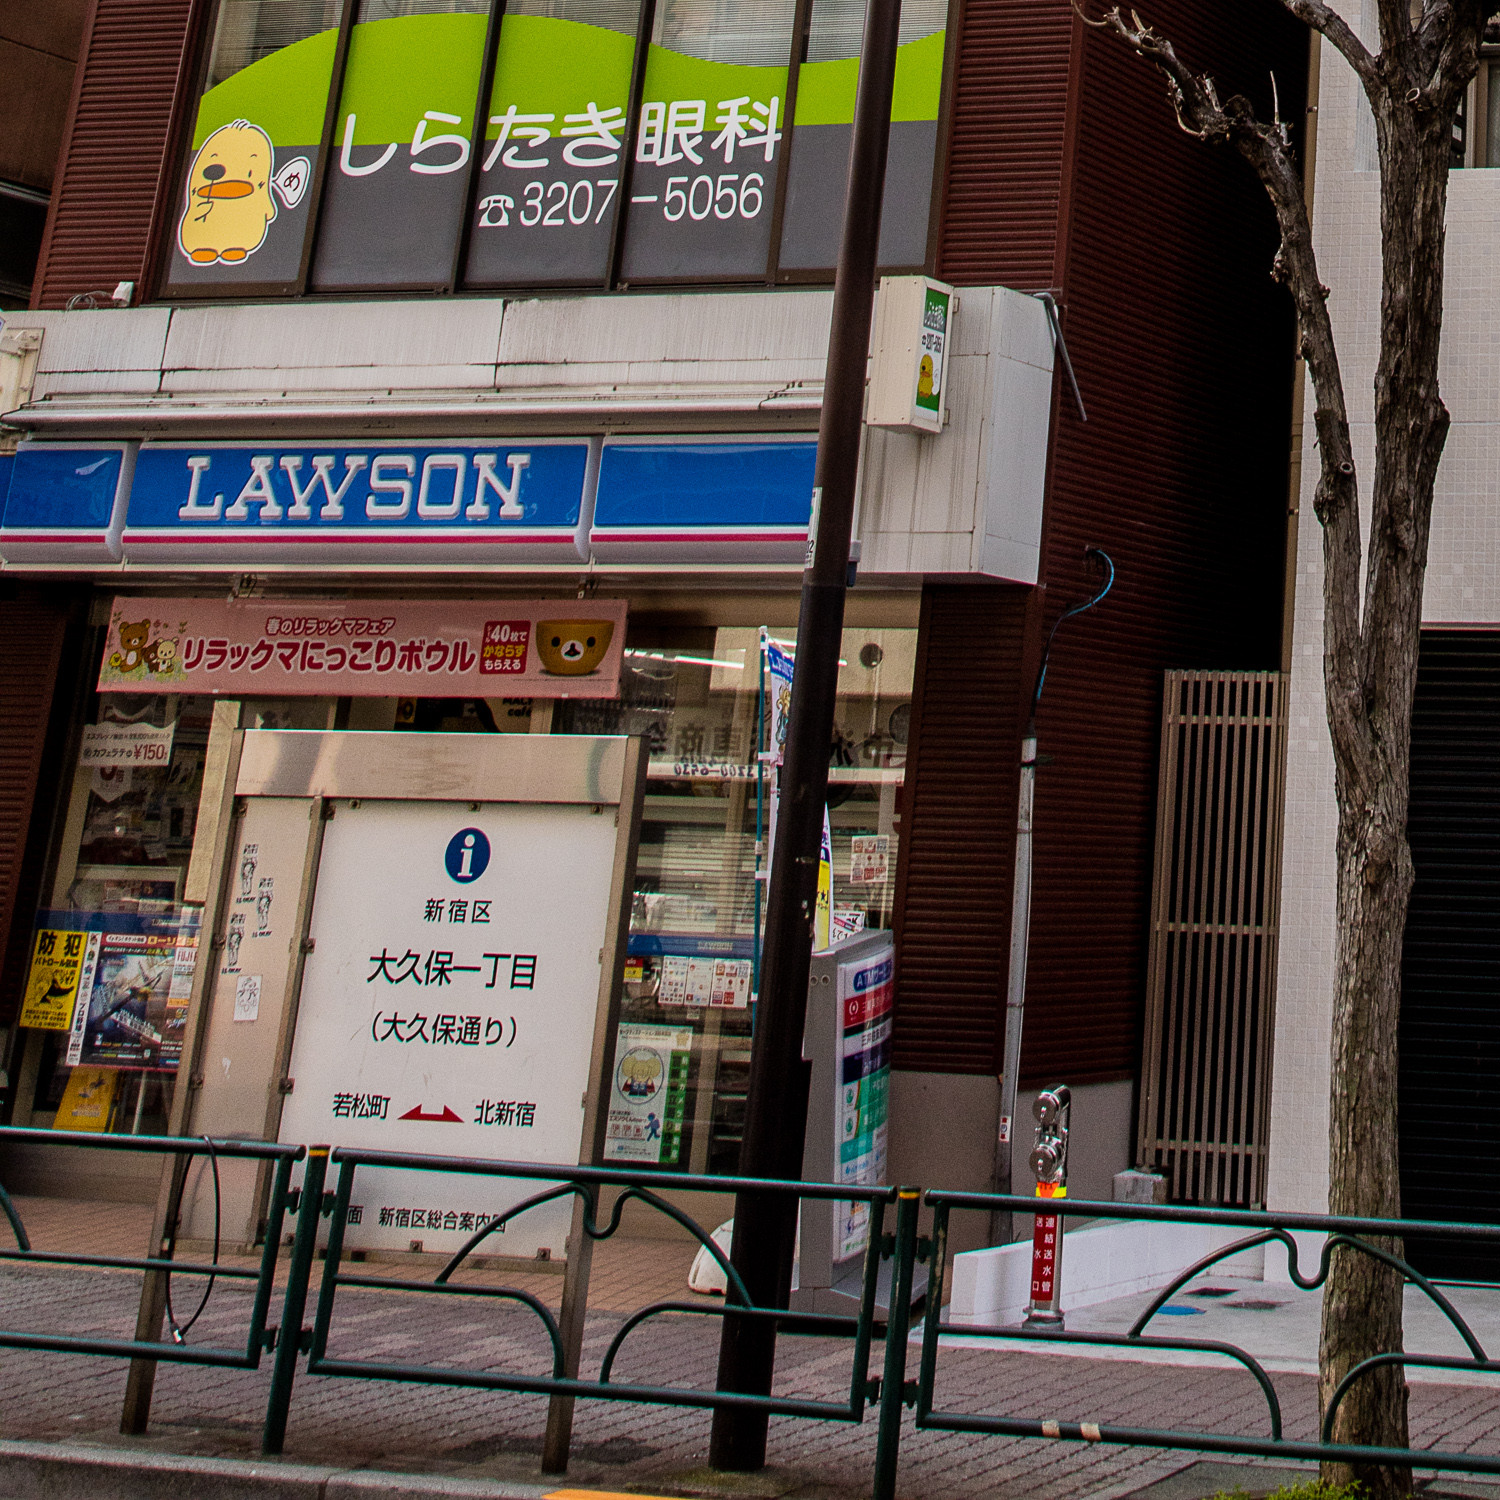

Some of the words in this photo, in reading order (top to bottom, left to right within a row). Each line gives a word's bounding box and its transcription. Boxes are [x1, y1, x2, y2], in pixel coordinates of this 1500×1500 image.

[339, 95, 784, 177] しらたき眼科
[178, 452, 531, 522] LAWSON
[266, 616, 396, 636] 春のリラックマフェア
[182, 636, 477, 673] リラックマにっこりボウル
[483, 644, 526, 658] かならず
[483, 659, 522, 671] もらえる
[423, 897, 493, 923] 新宿区
[37, 931, 83, 957] 防犯
[367, 947, 538, 990] 大久保一丁目
[372, 1010, 518, 1048] （大久保通り）
[332, 1091, 392, 1120] 若松町
[474, 1098, 538, 1127] 北新宿
[1032, 1216, 1043, 1292] 送水口
[1041, 1216, 1055, 1292] 連結送水管
